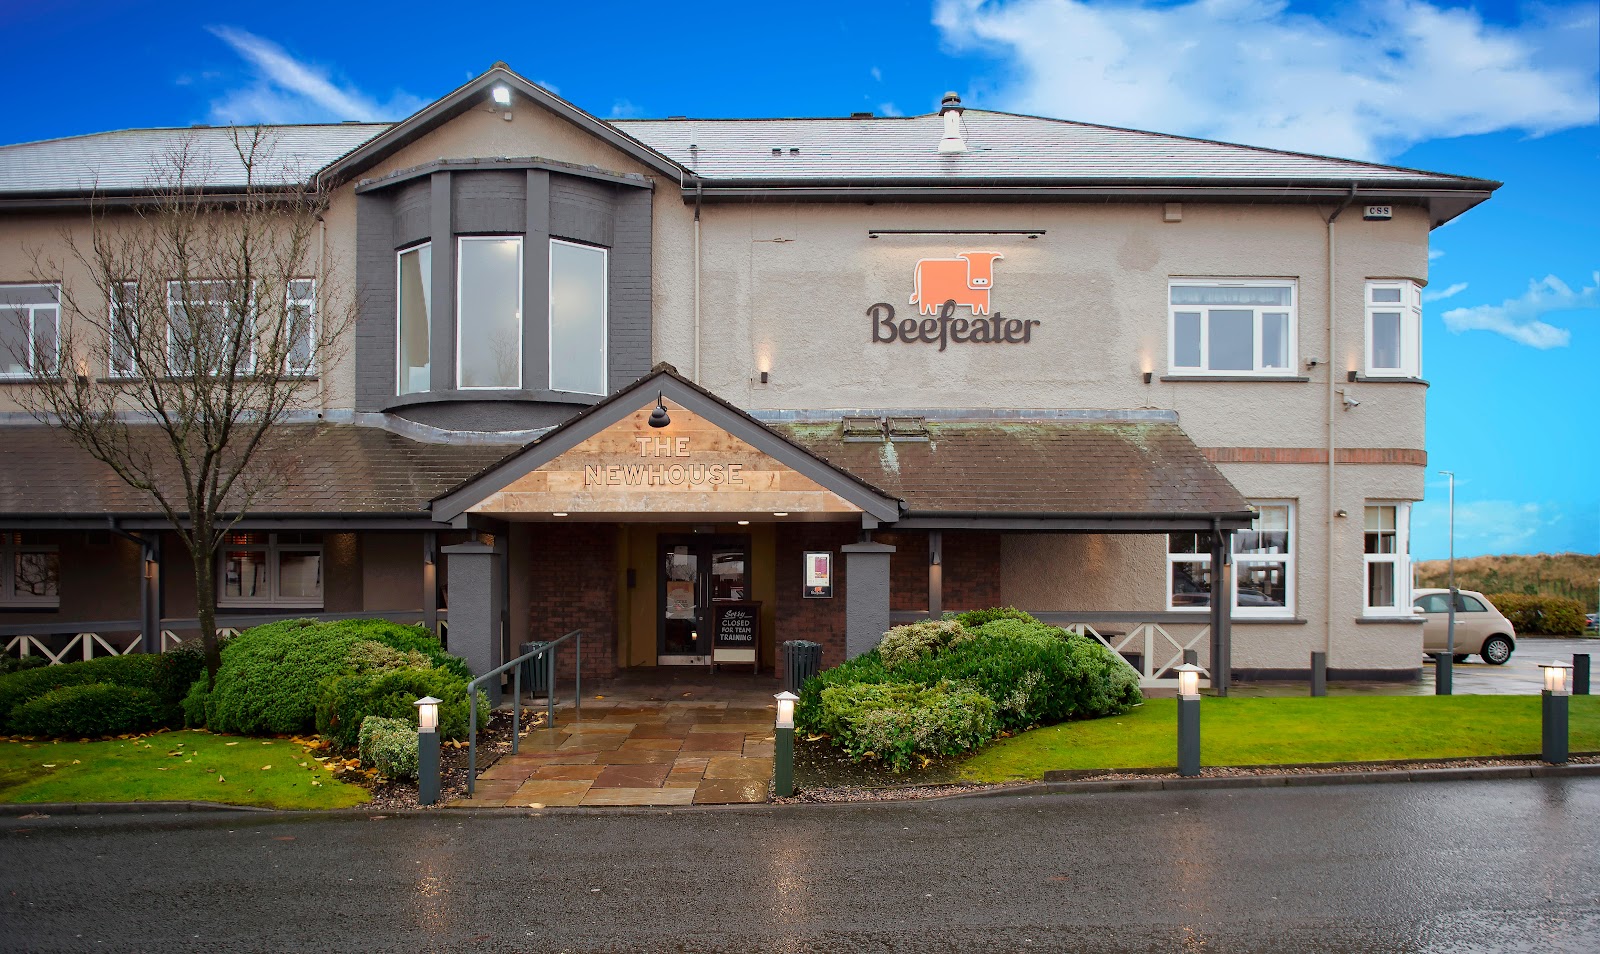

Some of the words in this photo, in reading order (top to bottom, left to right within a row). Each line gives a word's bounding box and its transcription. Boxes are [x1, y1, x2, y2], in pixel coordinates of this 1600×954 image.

[866, 299, 1041, 352] Beefeater
[635, 436, 691, 457] THE
[584, 464, 744, 485] NEWHOUSE
[721, 619, 750, 627] CLOSED
[720, 633, 752, 641] TRAINING
